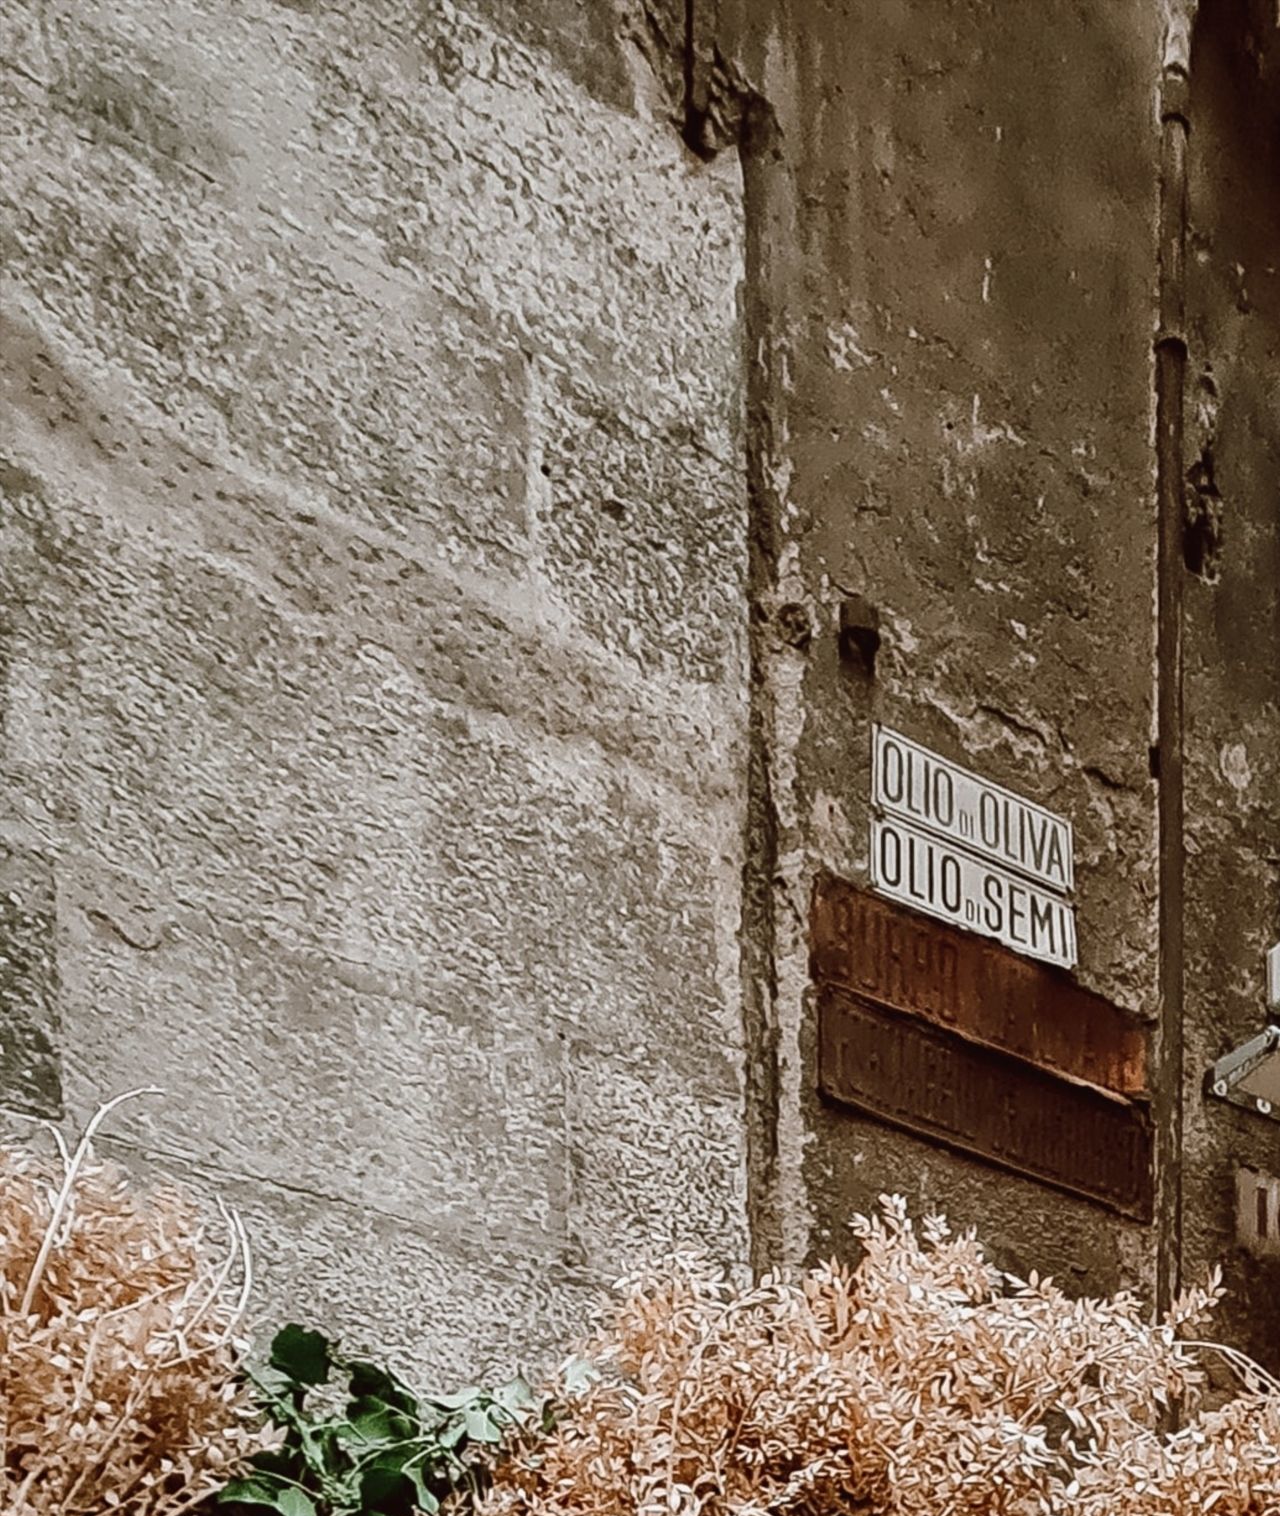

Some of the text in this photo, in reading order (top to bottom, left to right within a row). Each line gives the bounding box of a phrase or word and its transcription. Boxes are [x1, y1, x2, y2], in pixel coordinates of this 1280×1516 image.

[883, 741, 1065, 882] OLIO DI OLIVA
[881, 827, 1068, 959] OLIO DI SEMI
